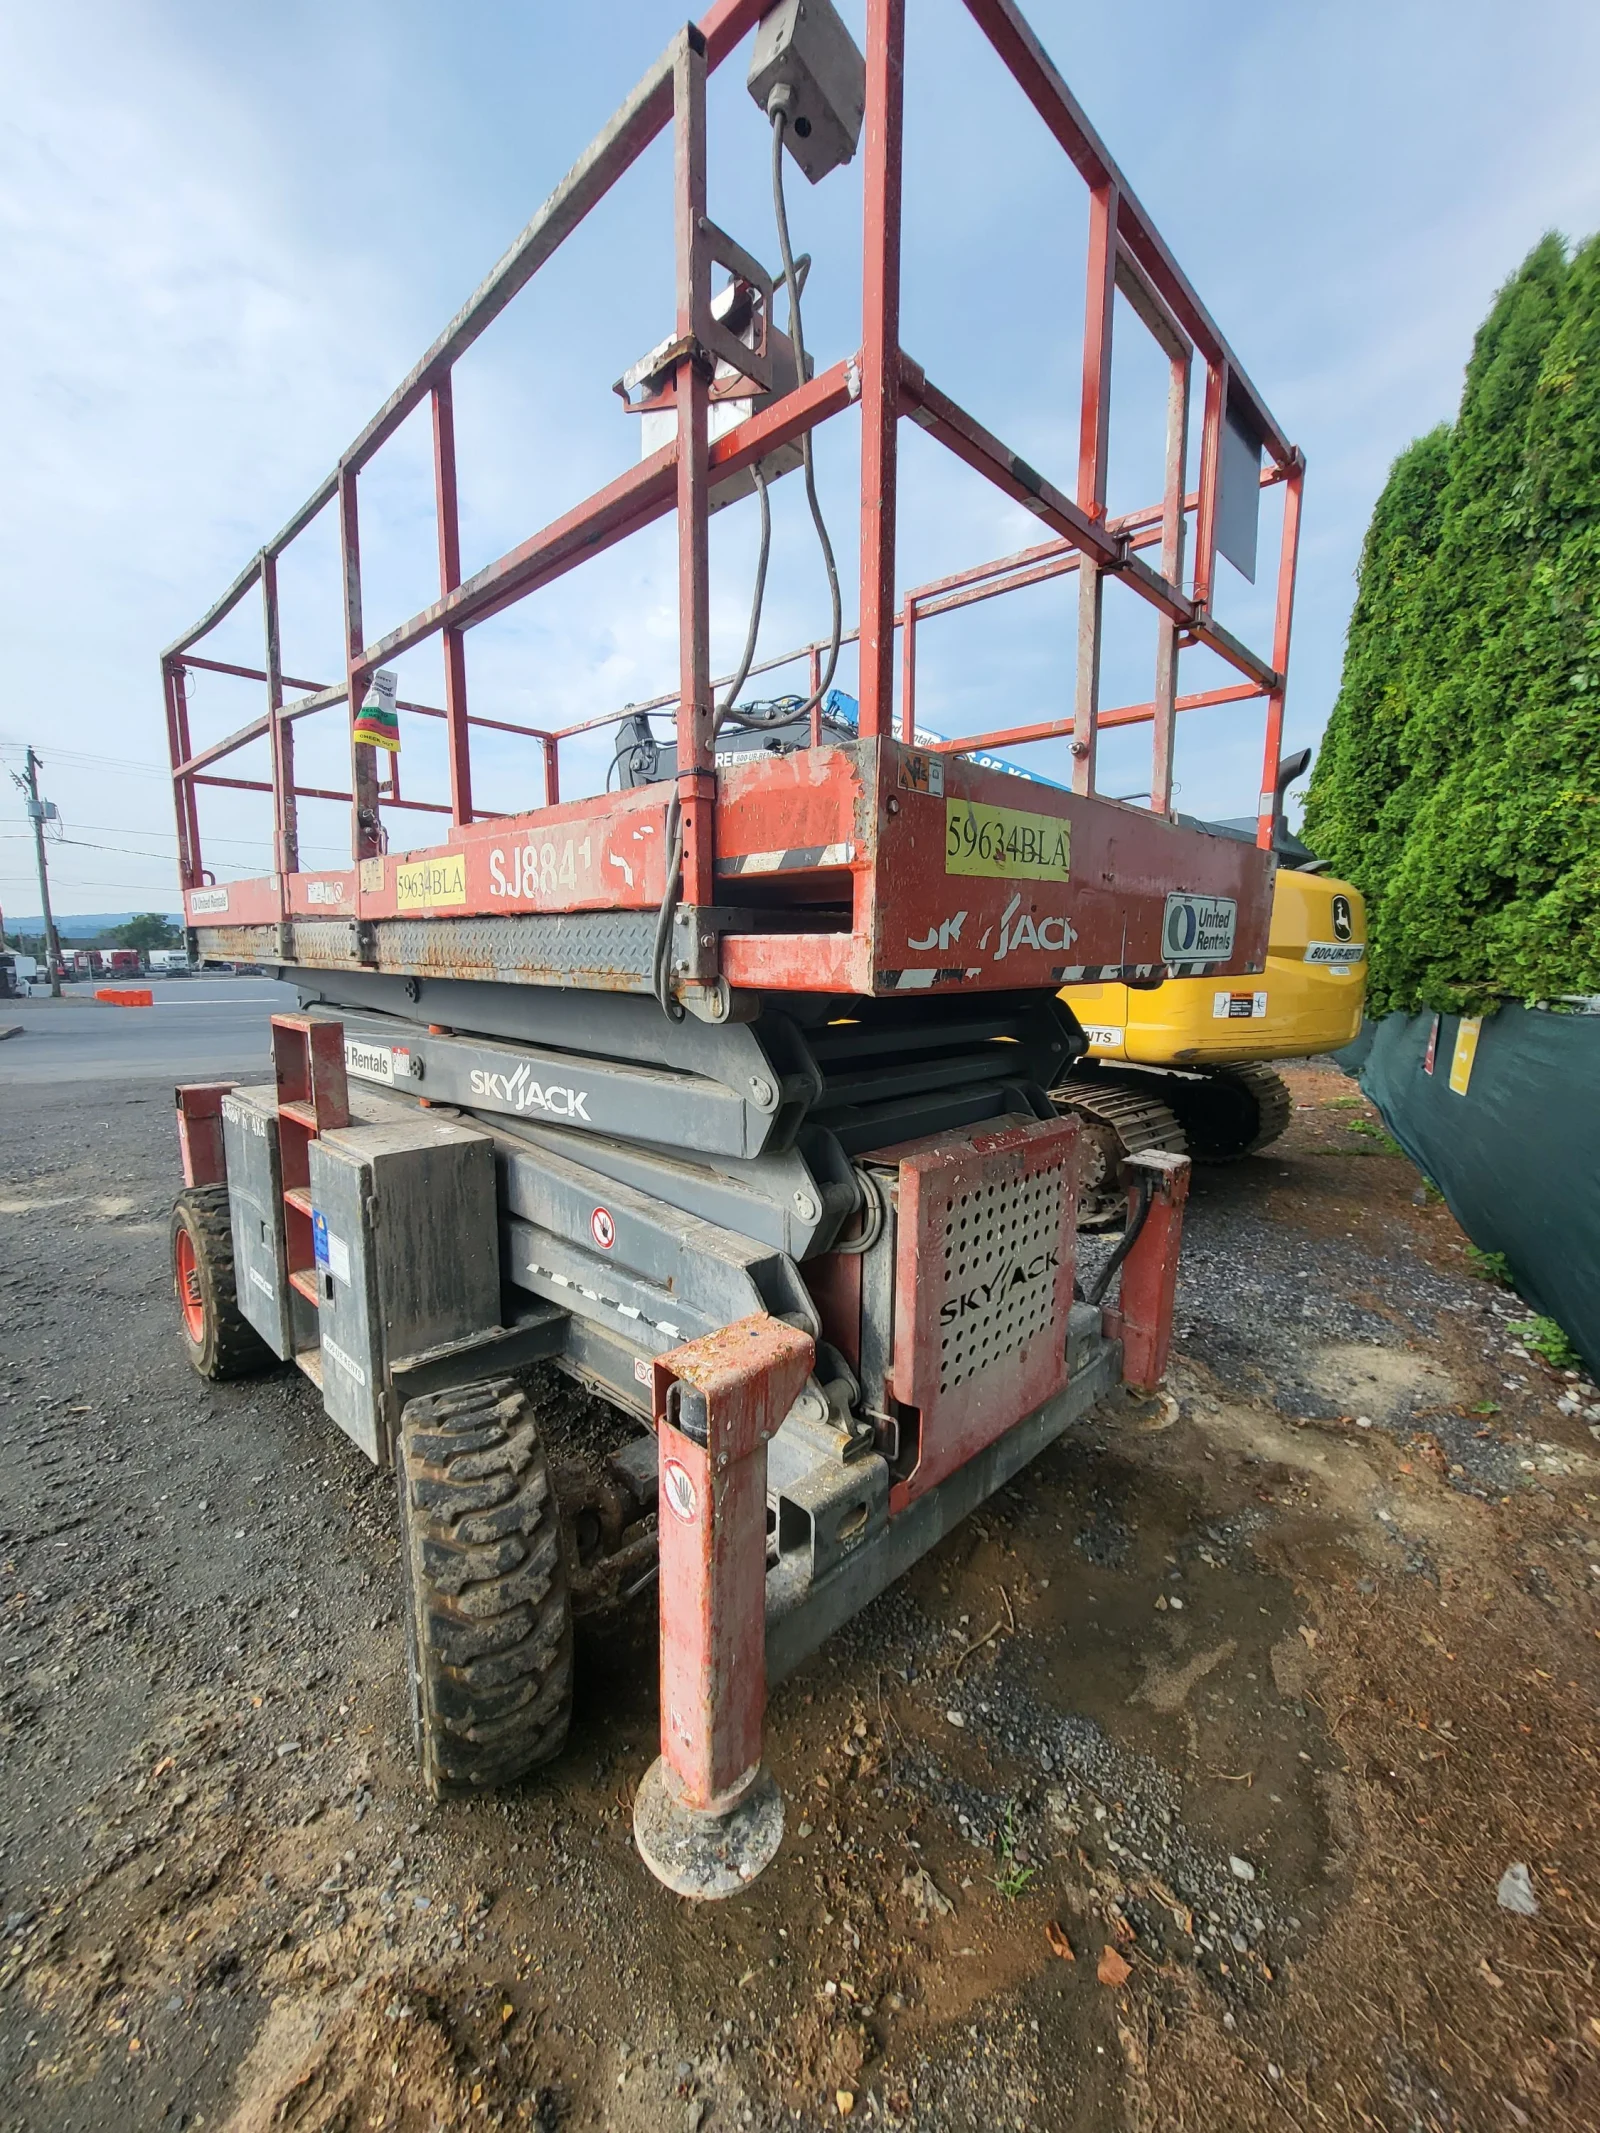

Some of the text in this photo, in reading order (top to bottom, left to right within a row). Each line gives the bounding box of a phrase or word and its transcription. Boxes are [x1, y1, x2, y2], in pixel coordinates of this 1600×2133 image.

[947, 816, 1068, 867] 59634BLA
[398, 865, 464, 900] 59634BLA
[1199, 907, 1230, 929] United
[1196, 930, 1231, 951] Rentals
[351, 1047, 388, 1075] Rentals
[469, 1062, 592, 1121] SKYJACK
